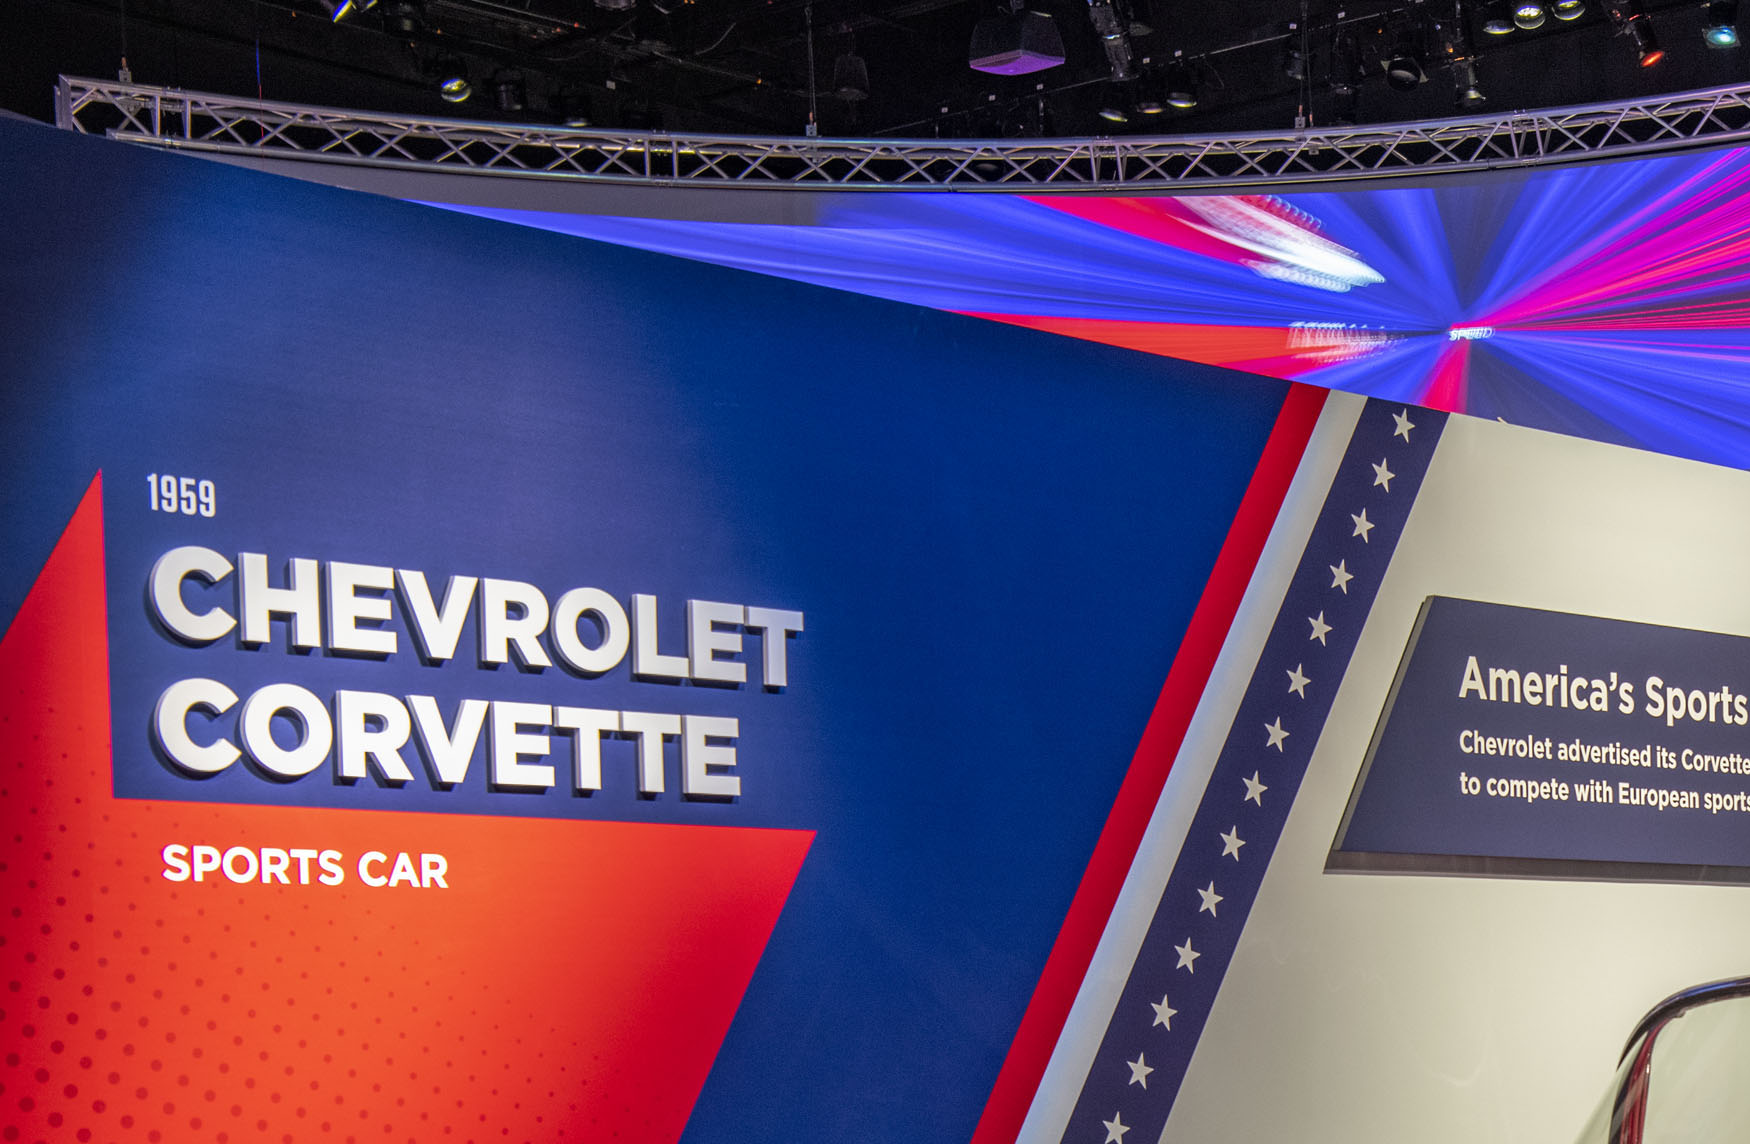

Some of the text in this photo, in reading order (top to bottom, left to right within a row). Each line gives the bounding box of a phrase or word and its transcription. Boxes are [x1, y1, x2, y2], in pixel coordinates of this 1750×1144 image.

[147, 473, 216, 518] 1959
[149, 546, 804, 689] CHEVROLET
[1458, 656, 1635, 714] America’s
[1645, 676, 1749, 727] Sports
[153, 678, 742, 796] CORVETTE
[1459, 730, 1553, 760] Chevrolet
[1557, 739, 1651, 767] advertised
[1656, 745, 1677, 771] its
[1460, 772, 1481, 796] to
[1486, 777, 1570, 803] compete
[1574, 779, 1614, 804] with
[1618, 782, 1700, 811] European
[162, 844, 449, 888] SPORTS CAR
